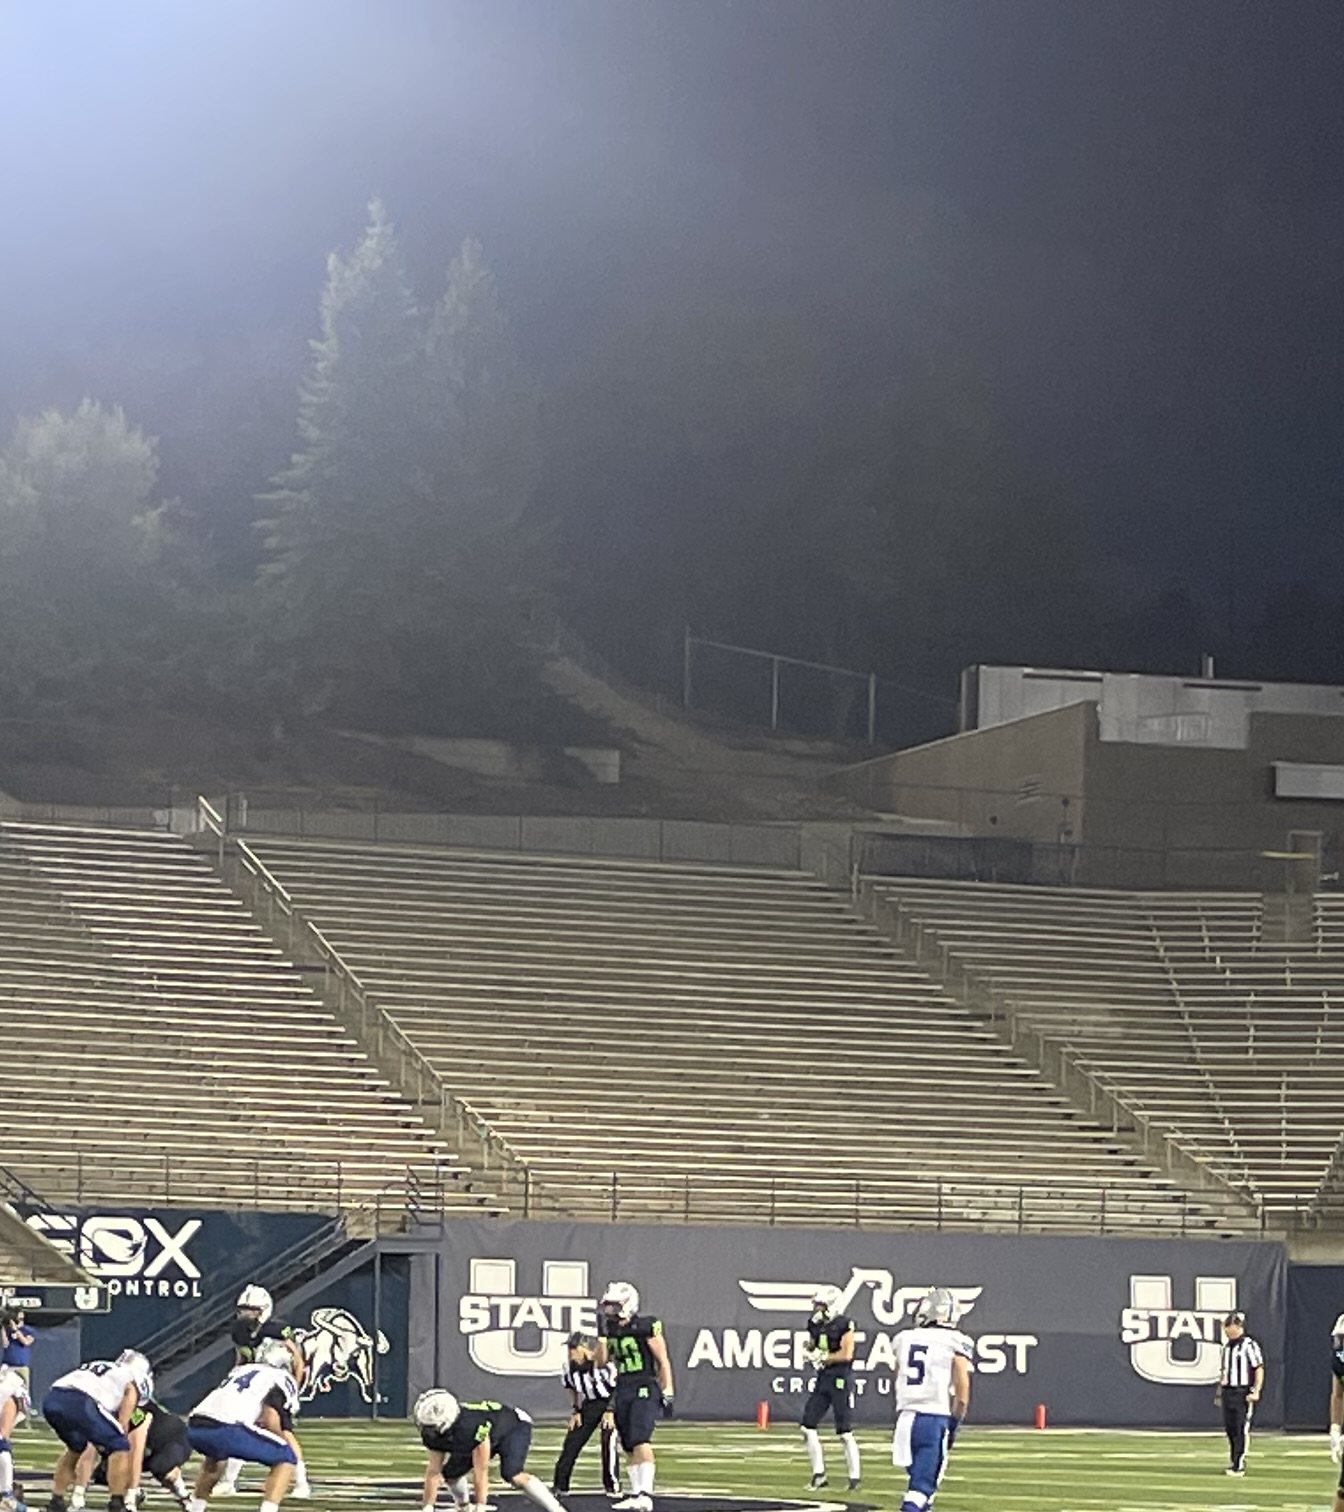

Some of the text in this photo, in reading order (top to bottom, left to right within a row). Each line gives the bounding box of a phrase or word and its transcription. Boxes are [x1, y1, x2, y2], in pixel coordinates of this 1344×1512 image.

[109, 1279, 203, 1297] ONTROL
[458, 1295, 599, 1336] STATE
[1121, 1308, 1245, 1343] STAT
[907, 1343, 929, 1386] 5
